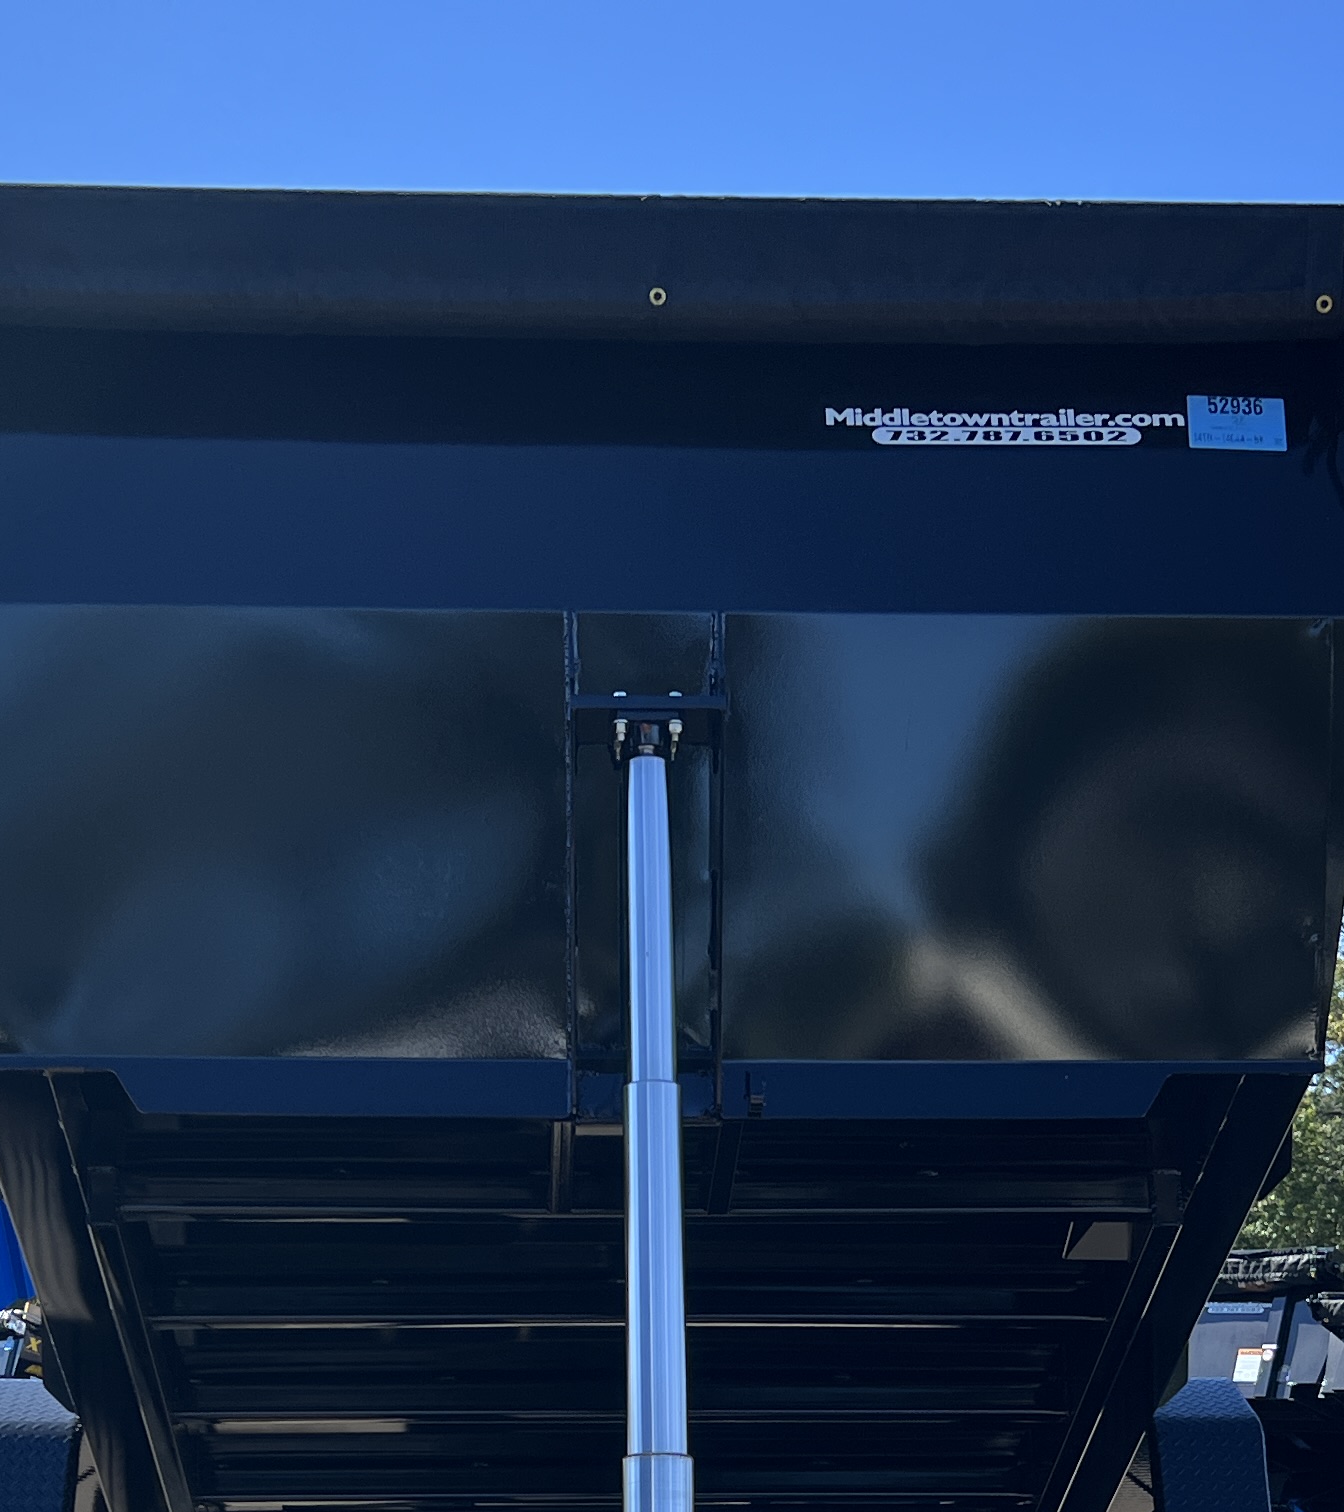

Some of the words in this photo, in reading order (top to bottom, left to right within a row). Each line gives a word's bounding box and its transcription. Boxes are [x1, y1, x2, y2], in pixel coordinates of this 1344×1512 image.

[1208, 397, 1263, 415] 52936
[825, 407, 1185, 427] Middletowntrailer.com
[883, 429, 1130, 443] 732.787.6502
